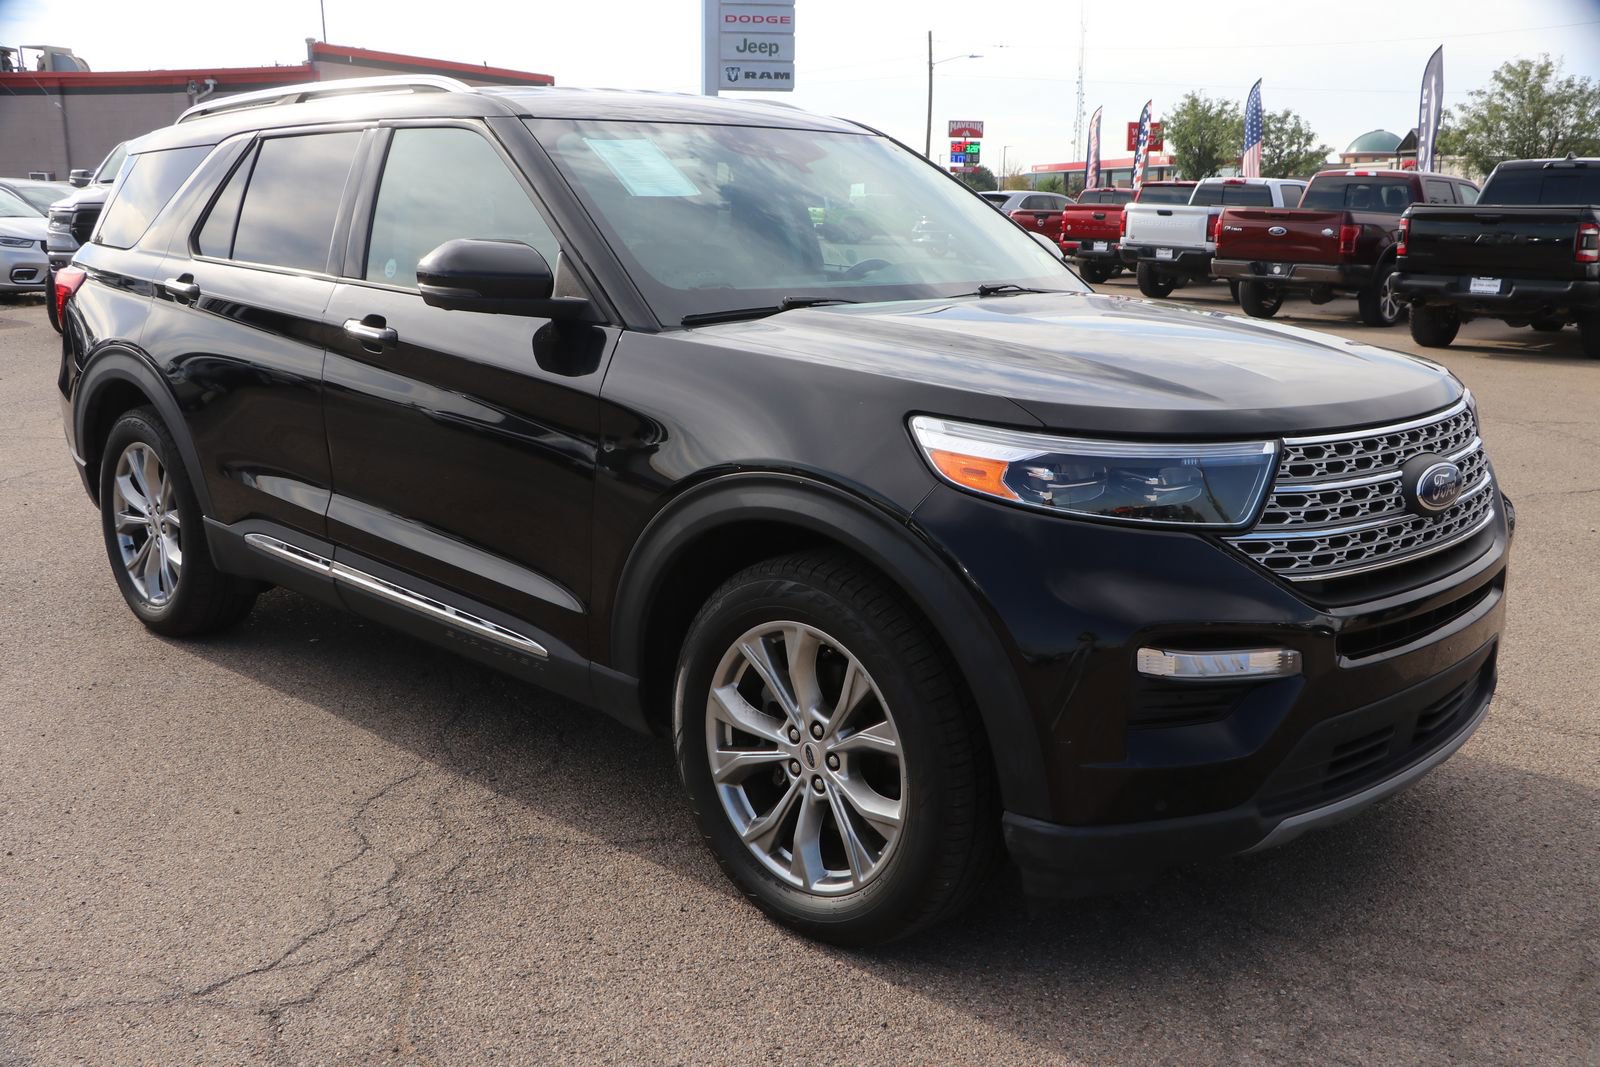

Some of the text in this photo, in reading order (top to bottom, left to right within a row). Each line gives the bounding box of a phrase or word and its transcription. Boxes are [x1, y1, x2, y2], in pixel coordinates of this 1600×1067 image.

[725, 15, 791, 24] DODGE
[736, 38, 779, 57] Jeep
[744, 71, 790, 80] RAM
